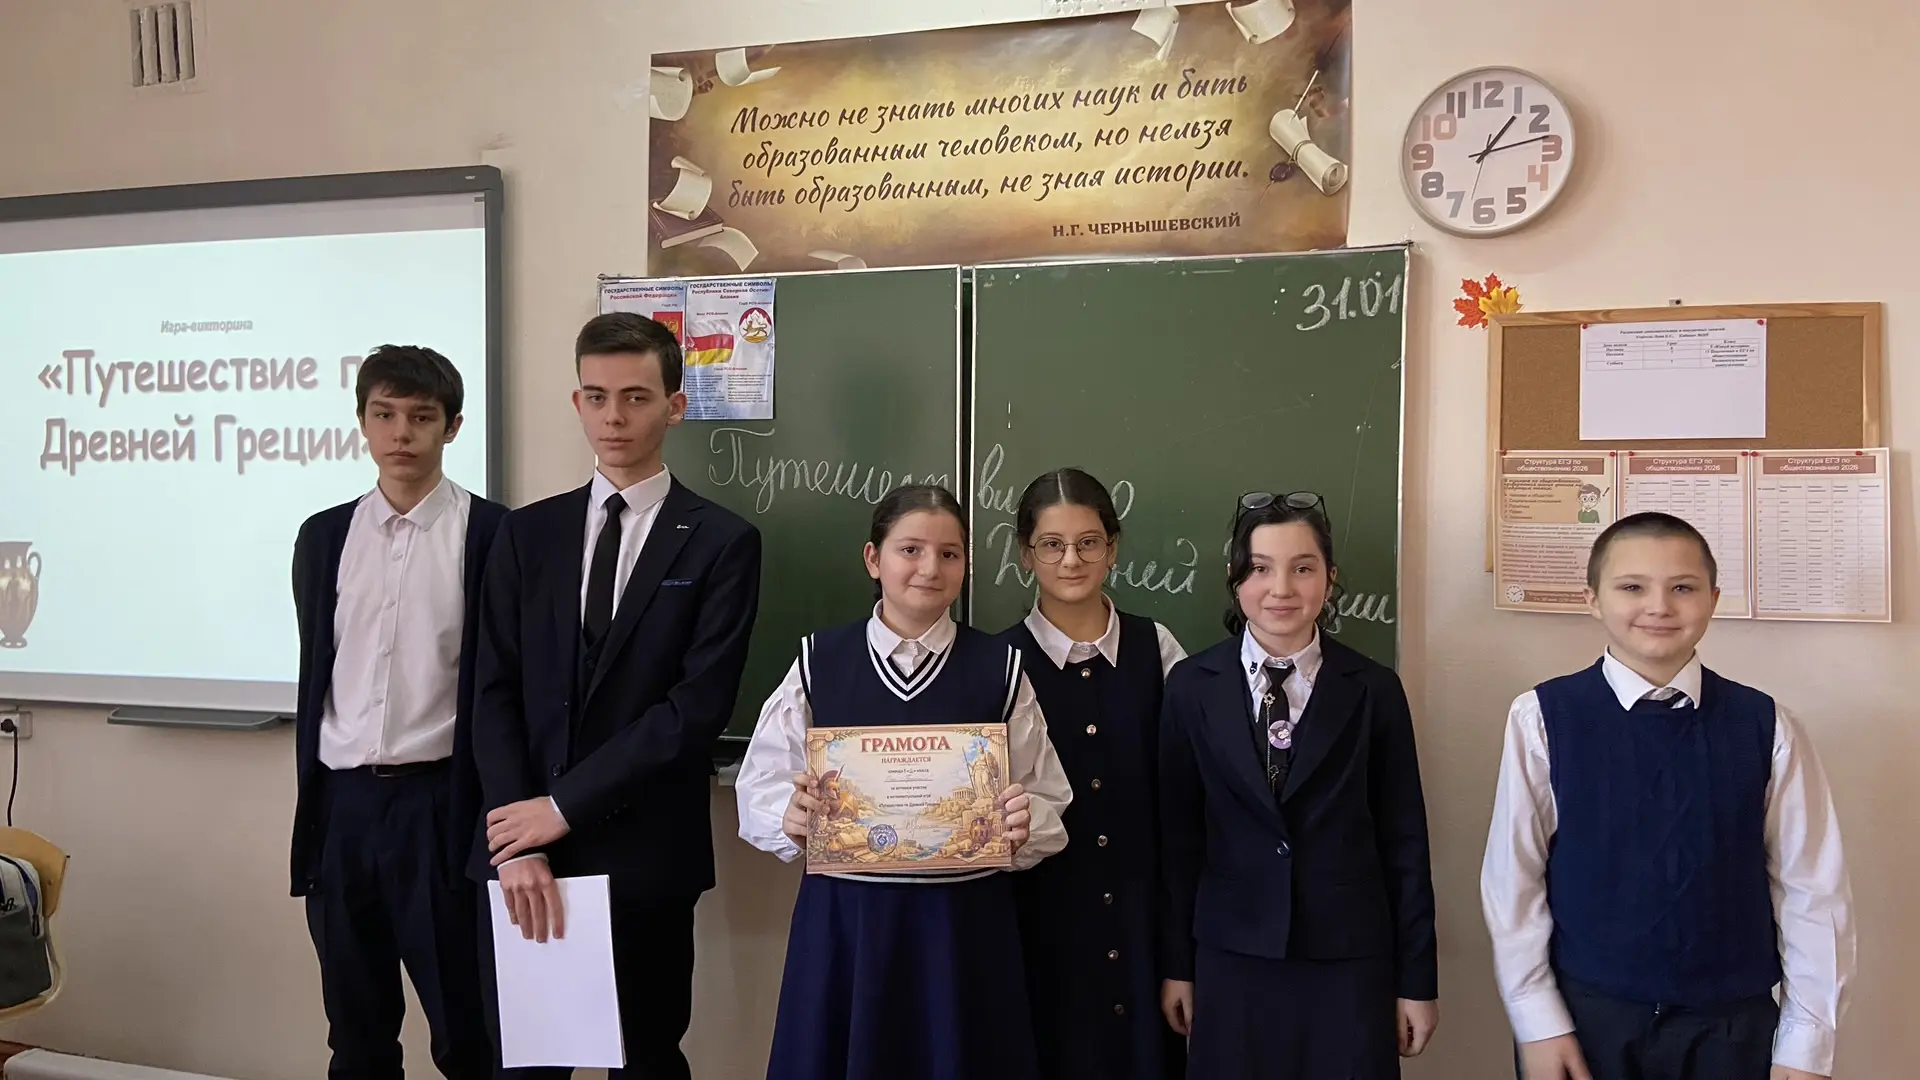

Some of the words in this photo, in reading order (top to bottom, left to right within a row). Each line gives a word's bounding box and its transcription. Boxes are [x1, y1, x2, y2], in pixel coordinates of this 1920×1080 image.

[730, 106, 829, 134] Можно
[838, 107, 868, 126] не
[870, 100, 955, 134] знать
[965, 90, 1065, 116] многих
[1072, 85, 1141, 116] наук
[1150, 82, 1168, 101] и
[1176, 68, 1248, 99] быть
[1446, 91, 1467, 119] 11
[1472, 80, 1504, 110] 12
[1422, 113, 1458, 142] 10
[1528, 104, 1550, 134] 2
[742, 136, 929, 178] образованным
[937, 124, 1083, 158] человеком,
[1094, 127, 1130, 148] но
[1138, 118, 1233, 150] нельзя
[1411, 143, 1434, 171] 9
[1541, 134, 1563, 163] 3
[728, 179, 786, 208] быть
[794, 171, 989, 213] образованным,
[1000, 174, 1033, 194] не
[1033, 169, 1106, 202] зная
[1114, 159, 1249, 193] истории.
[1420, 171, 1444, 198] 8
[1527, 163, 1549, 191] 4
[1446, 190, 1466, 218] 7
[1472, 197, 1496, 225] 6
[1506, 187, 1527, 215] 5
[1052, 224, 1084, 237] Н.Г.
[1087, 212, 1241, 236] ЧЕРНЫШЕВСКИЙ
[604, 286, 655, 294] ГОСУДАРСТВЕННЫЕ
[1296, 274, 1401, 331] 31.01
[160, 318, 254, 337] Игра-викторина
[37, 348, 319, 409] «Путешествие
[340, 355, 364, 390] п
[39, 413, 197, 477] Древней
[213, 414, 369, 476] Греции
[1523, 458, 1557, 466] Структура
[1652, 458, 1687, 466] Структура
[1787, 457, 1824, 465] Структура
[860, 735, 952, 753] ГРАМОТА
[881, 756, 932, 764] НАГРАЖДАЕТСЯ
